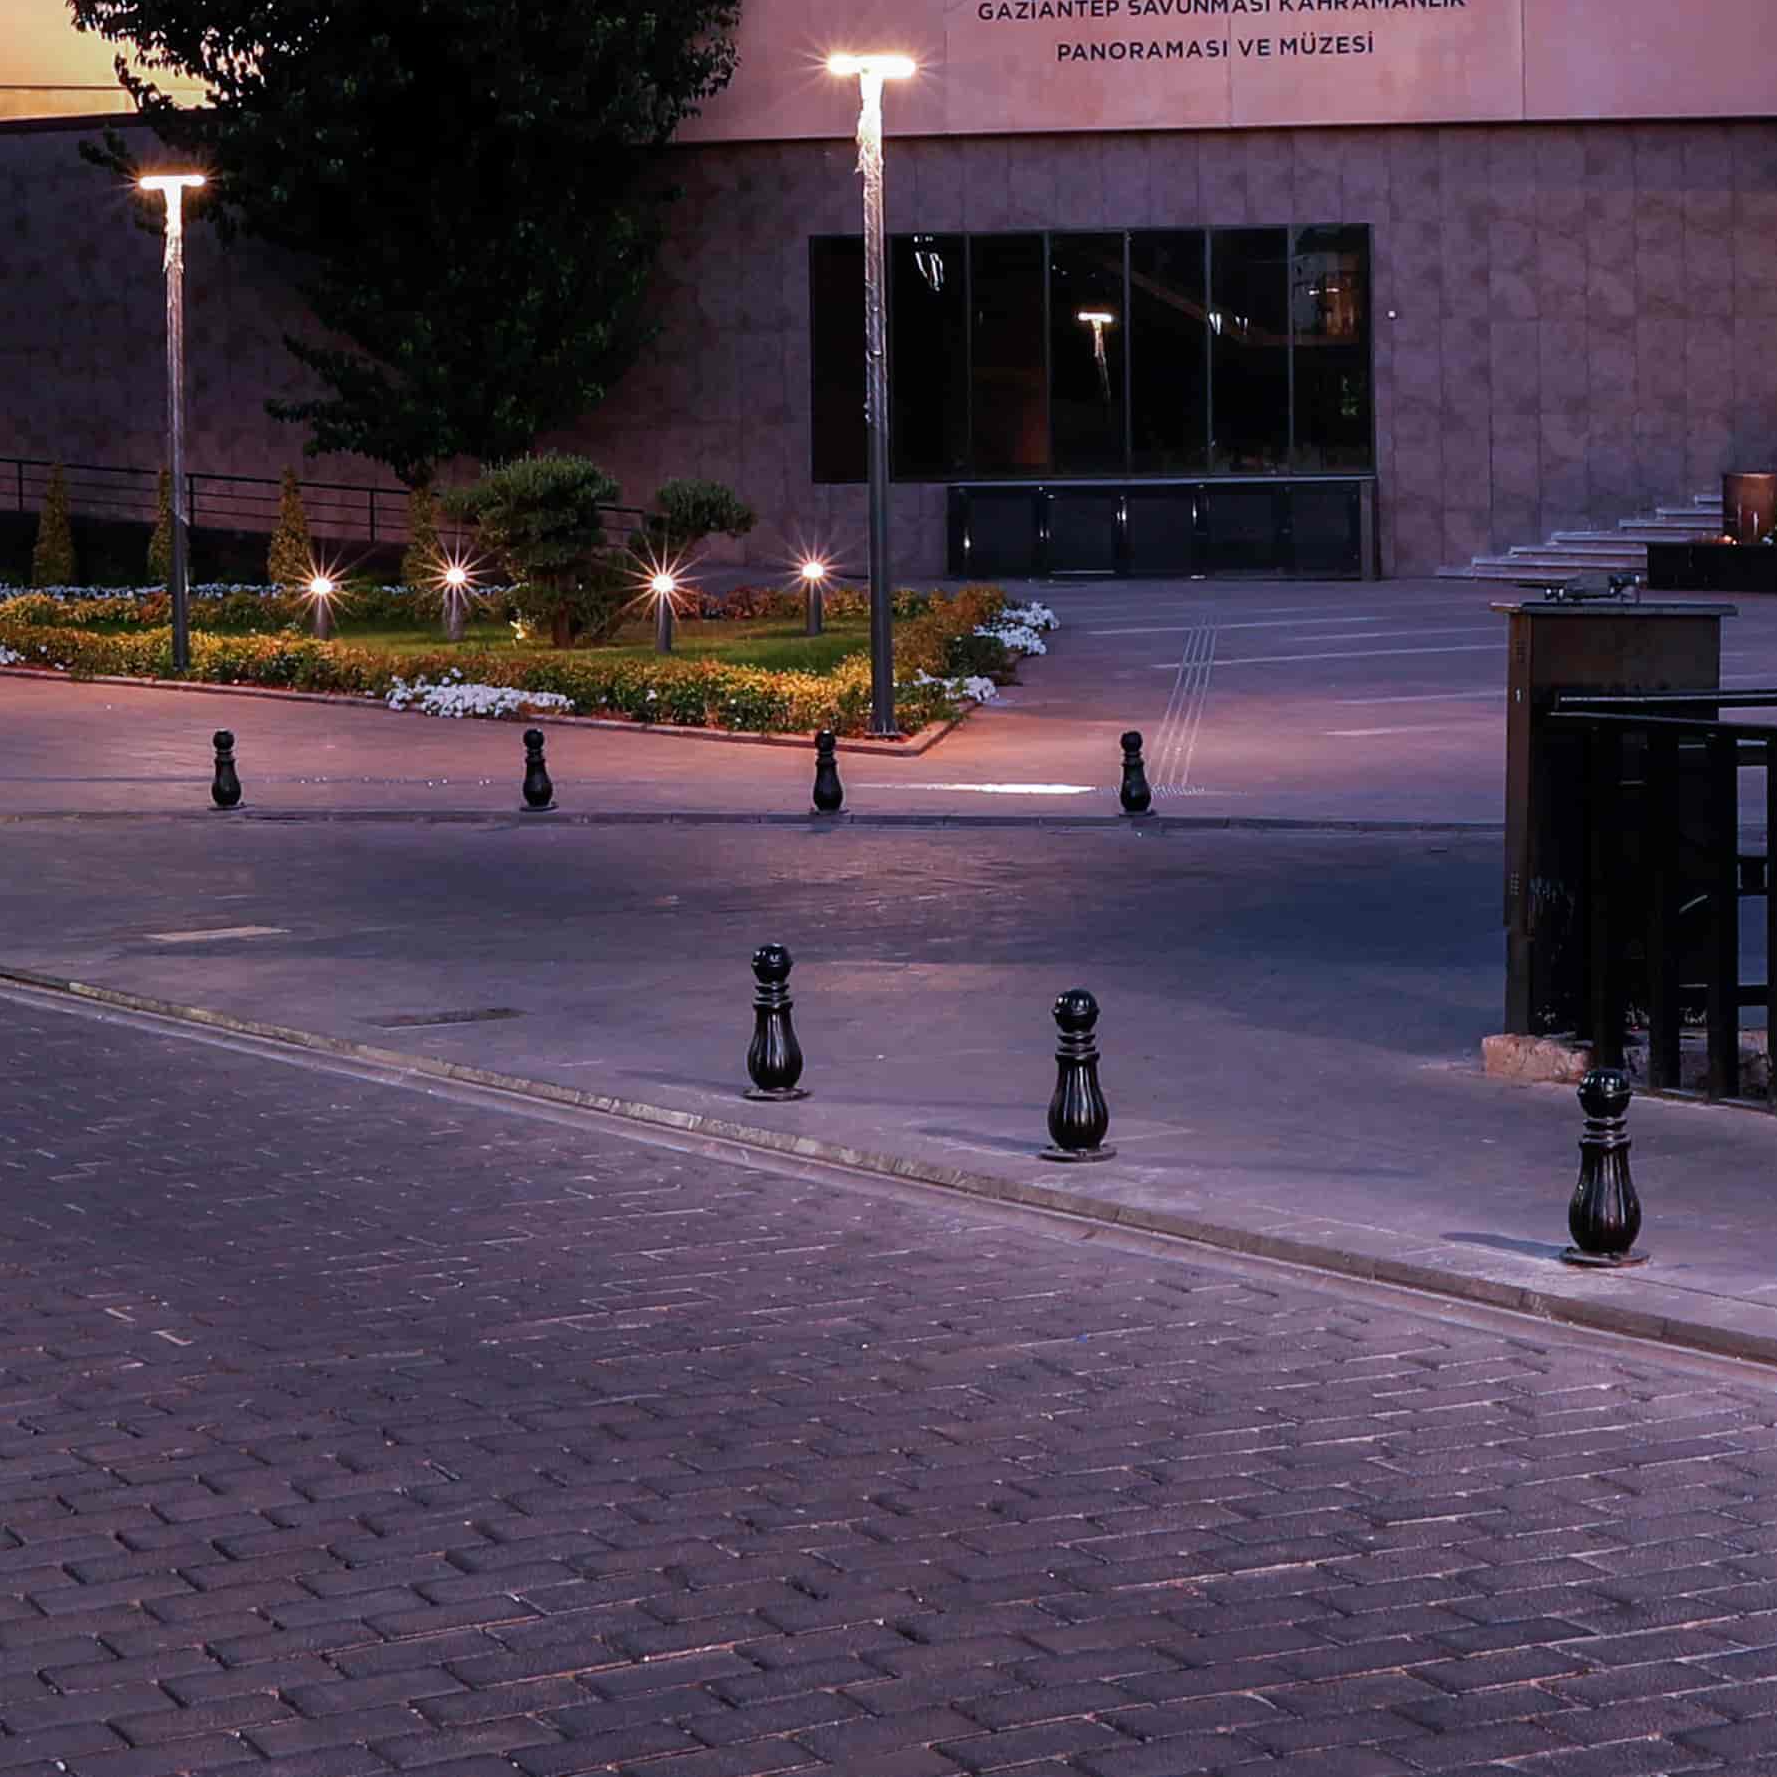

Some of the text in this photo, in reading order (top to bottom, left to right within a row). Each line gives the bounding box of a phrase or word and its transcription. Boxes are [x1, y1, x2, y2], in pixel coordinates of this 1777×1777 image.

[1057, 32, 1373, 62] PANORAMASI VE MÜZESİ
